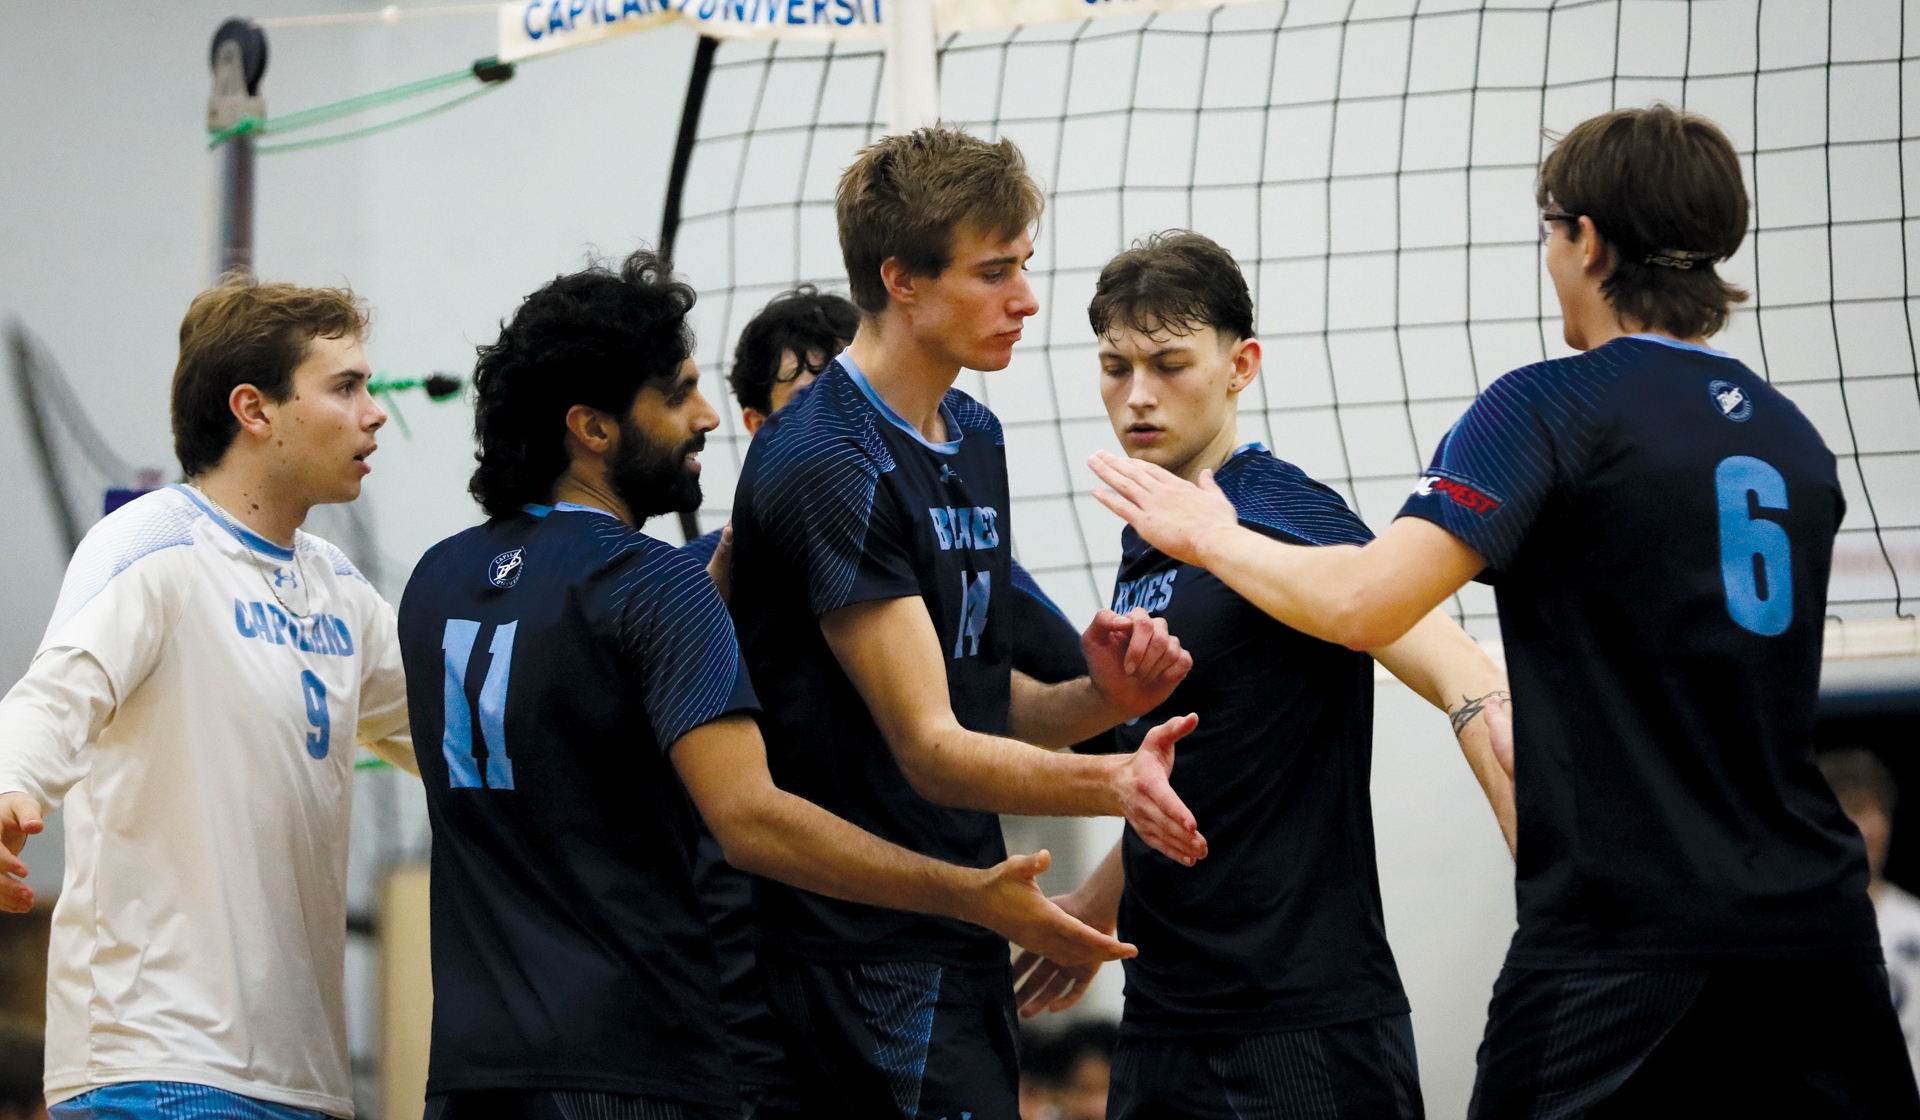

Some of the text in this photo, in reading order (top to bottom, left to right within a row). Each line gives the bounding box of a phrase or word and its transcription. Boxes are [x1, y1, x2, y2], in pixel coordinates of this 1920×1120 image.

[523, 0, 883, 40] CAPILA UNIVERSIT
[1643, 254, 1693, 269] HEAD
[1410, 476, 1498, 513] ACWEST
[1715, 455, 1793, 637] 6
[953, 570, 991, 659] 14
[300, 669, 330, 760] 9
[441, 618, 519, 790] 11
